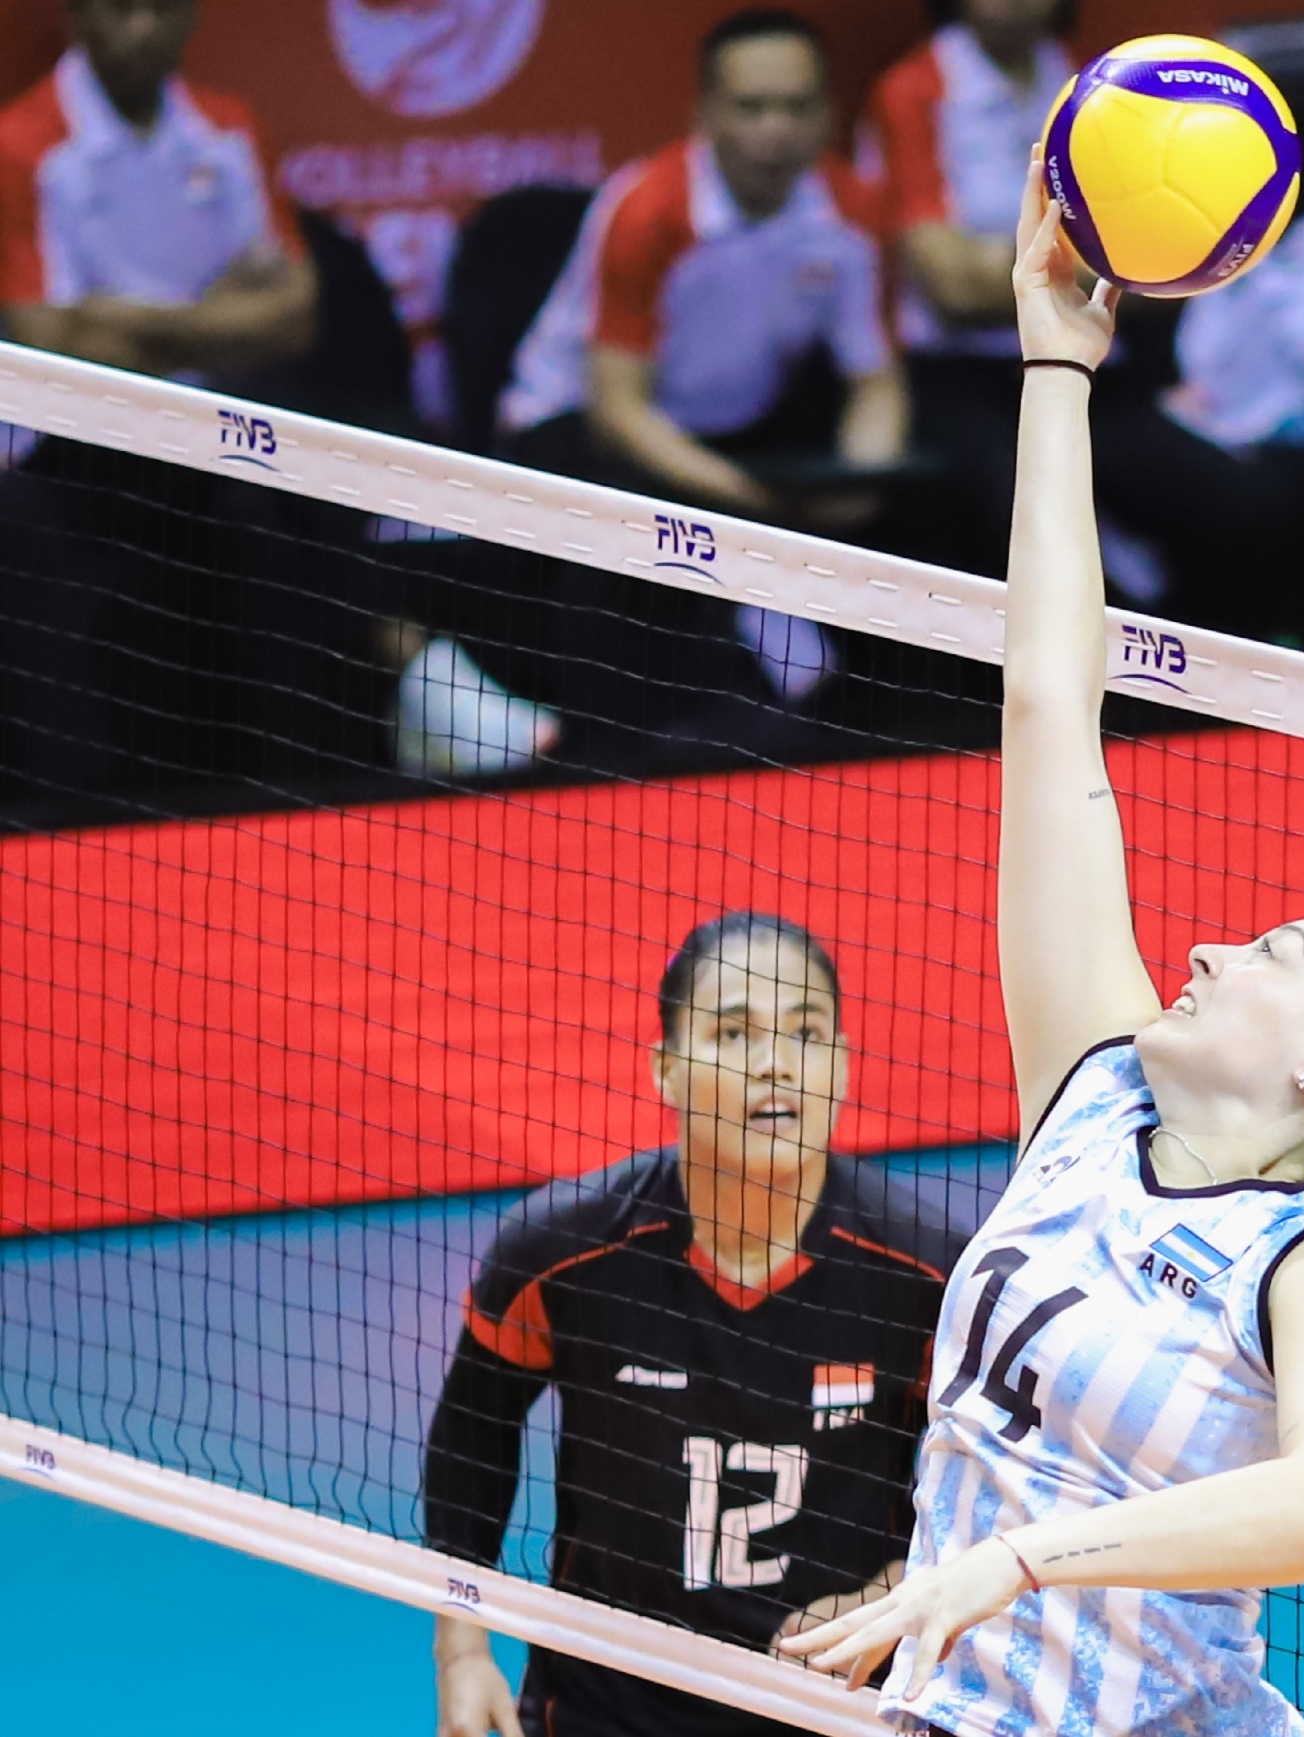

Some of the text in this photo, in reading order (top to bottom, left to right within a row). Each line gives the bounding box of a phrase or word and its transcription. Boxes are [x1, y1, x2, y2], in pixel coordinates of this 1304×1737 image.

[1048, 154, 1077, 220] V200W
[218, 409, 277, 455] FIVB
[655, 514, 716, 562] FIVB
[1122, 625, 1187, 674] FIVB
[1139, 1253, 1198, 1300] ARG
[936, 1246, 1090, 1444] 14
[25, 1443, 56, 1471] FIVB
[682, 1436, 810, 1592] 12
[447, 1577, 481, 1605] FIVB
